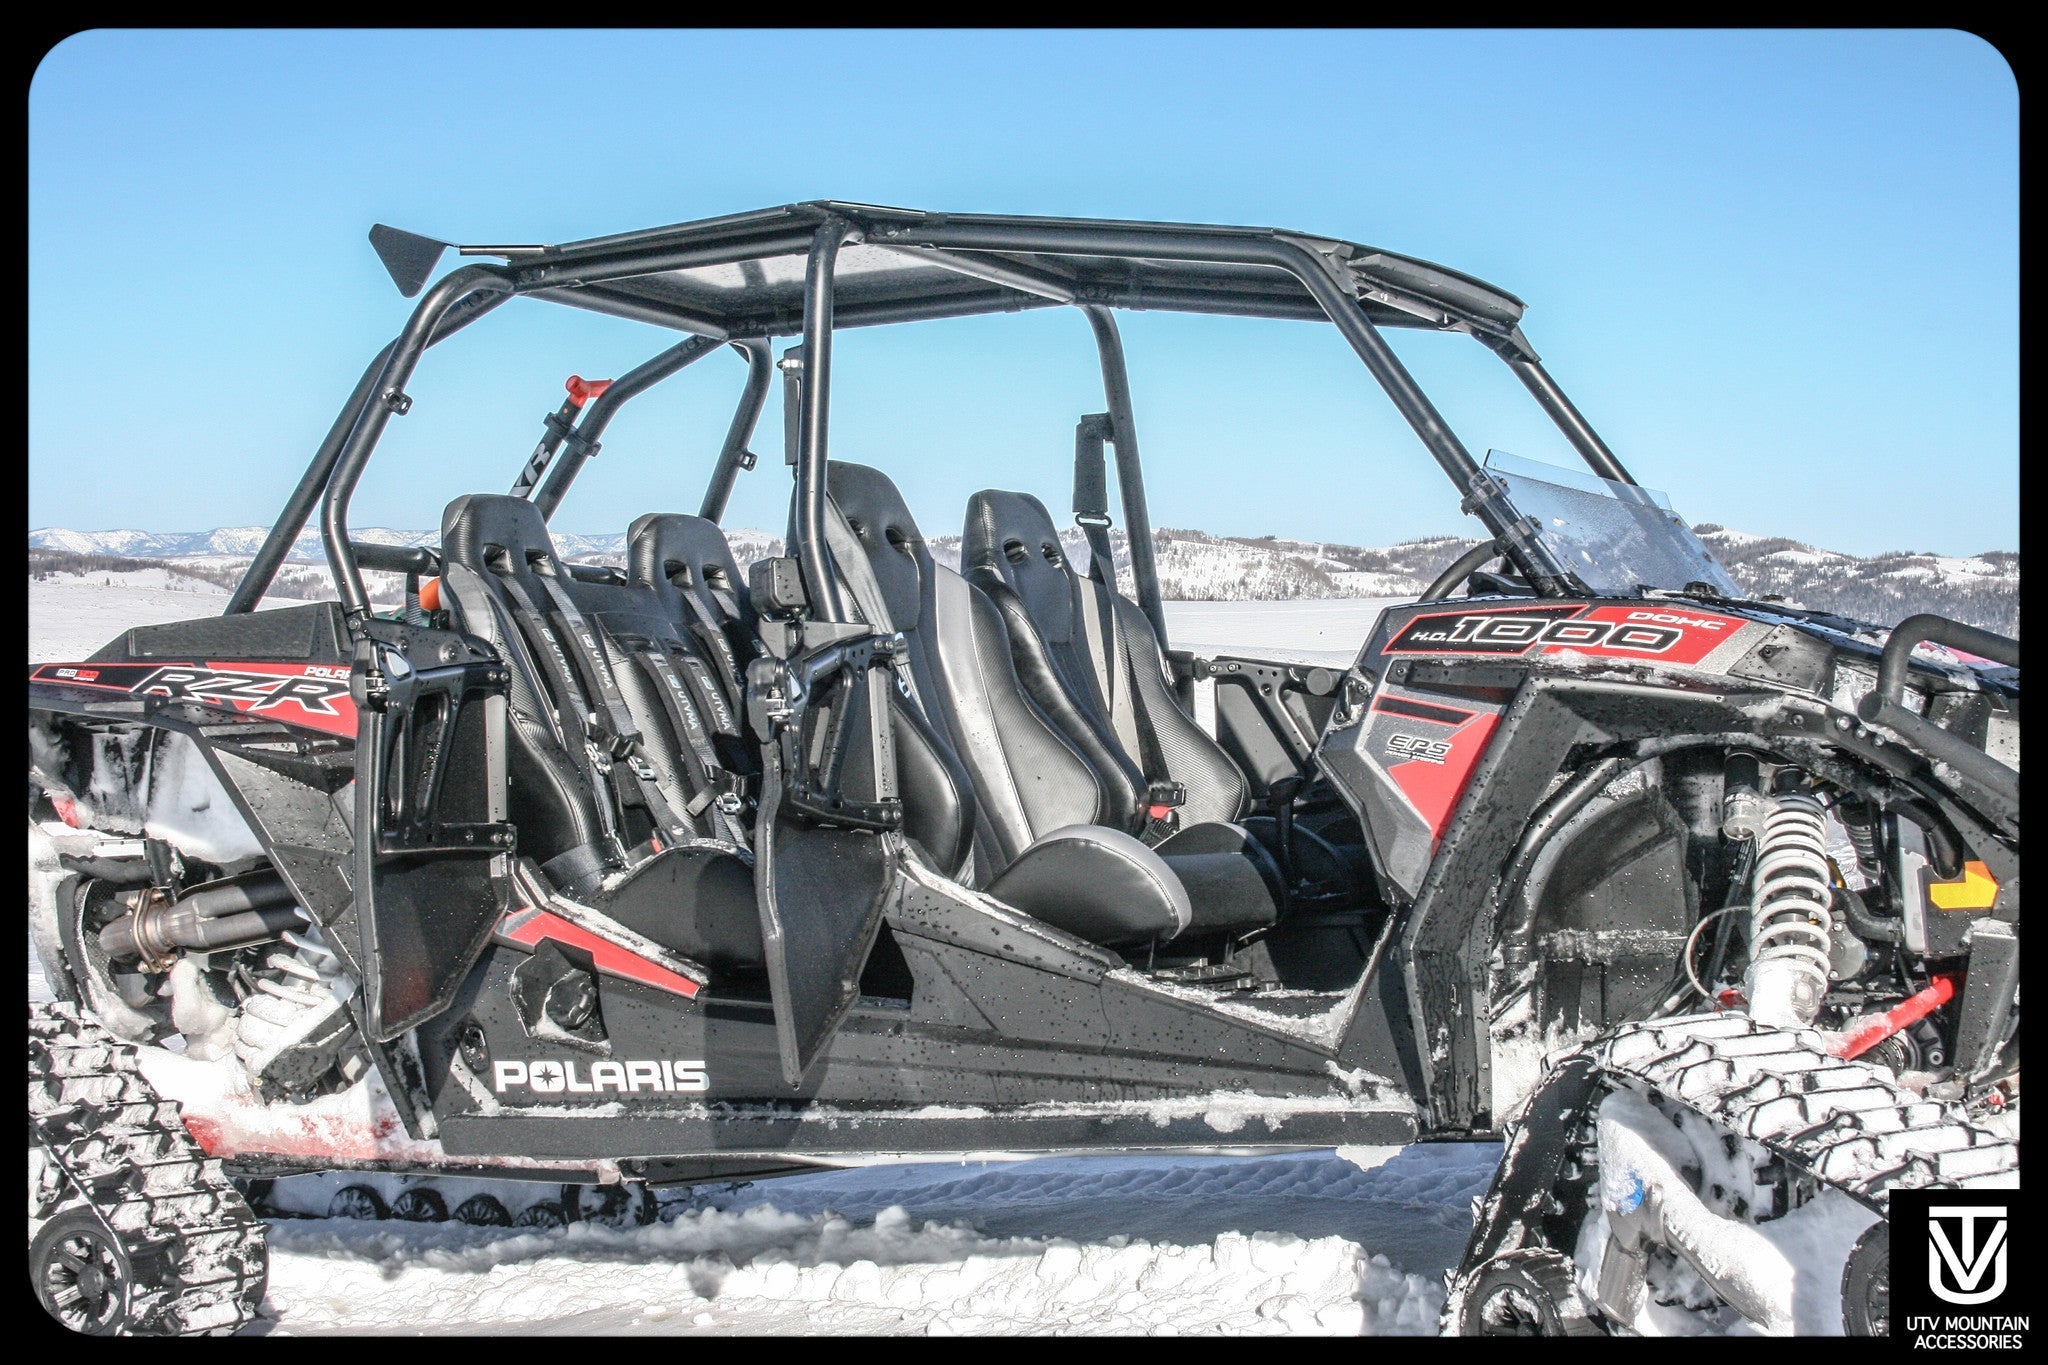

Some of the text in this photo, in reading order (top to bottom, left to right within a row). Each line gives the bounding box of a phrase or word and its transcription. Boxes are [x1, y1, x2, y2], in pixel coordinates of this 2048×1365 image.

[1445, 616, 1684, 654] 1000
[1626, 611, 1727, 631] DOHC
[128, 666, 351, 716] RZR
[677, 691, 699, 731] UTVMA
[711, 692, 732, 731] UTVMA
[1386, 733, 1455, 758] EPS
[493, 1060, 711, 1093] POLARIS
